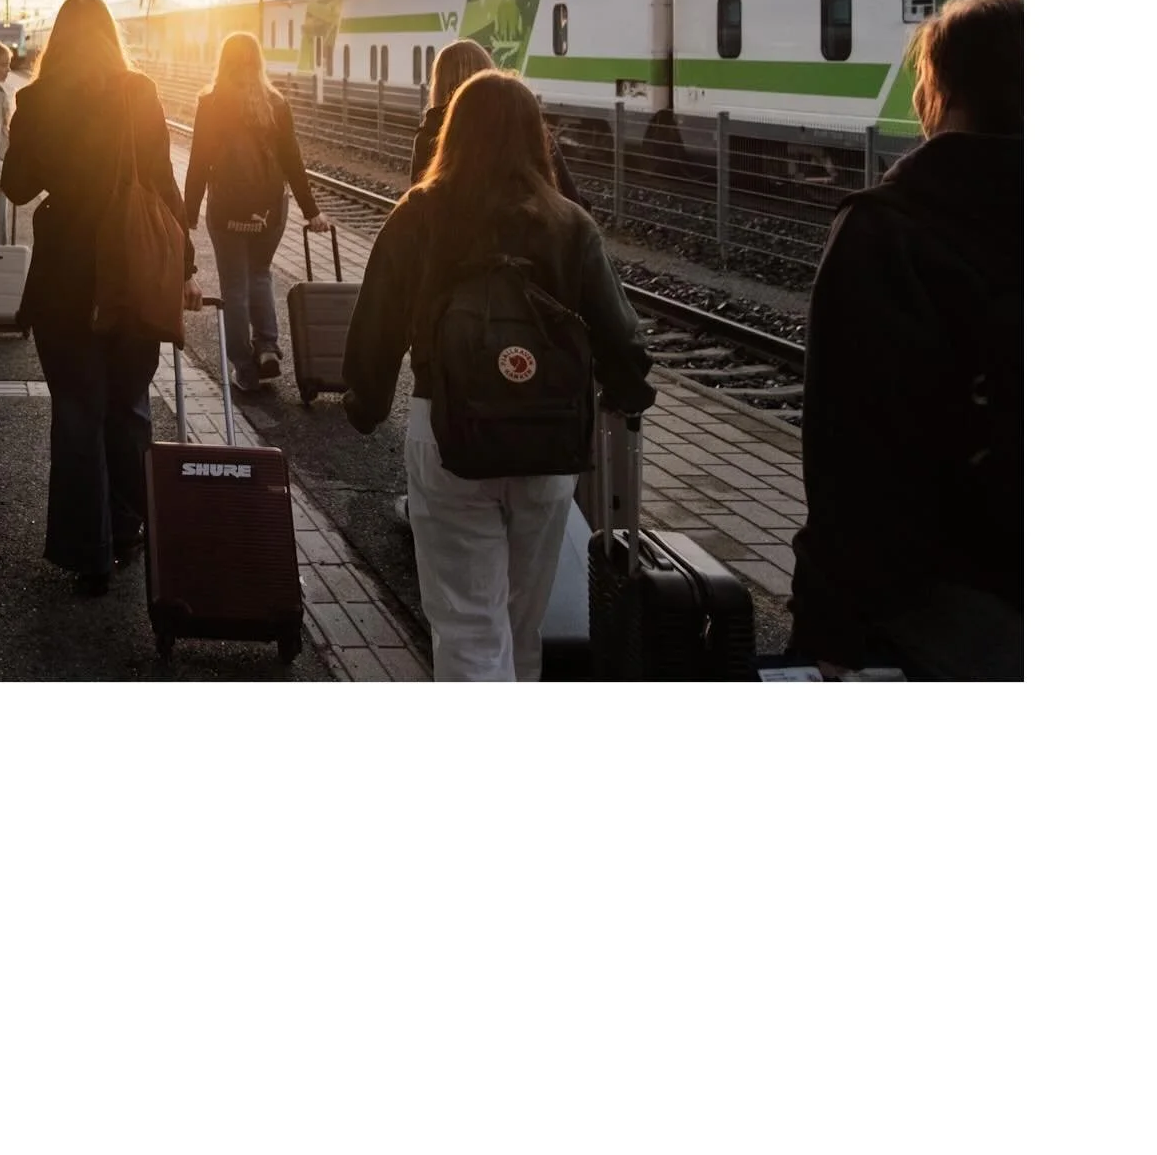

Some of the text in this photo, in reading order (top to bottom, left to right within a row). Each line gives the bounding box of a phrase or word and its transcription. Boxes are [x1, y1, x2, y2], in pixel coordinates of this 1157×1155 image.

[440, 11, 458, 32] VR
[227, 219, 263, 233] PUMA
[181, 462, 252, 479] SHURE
